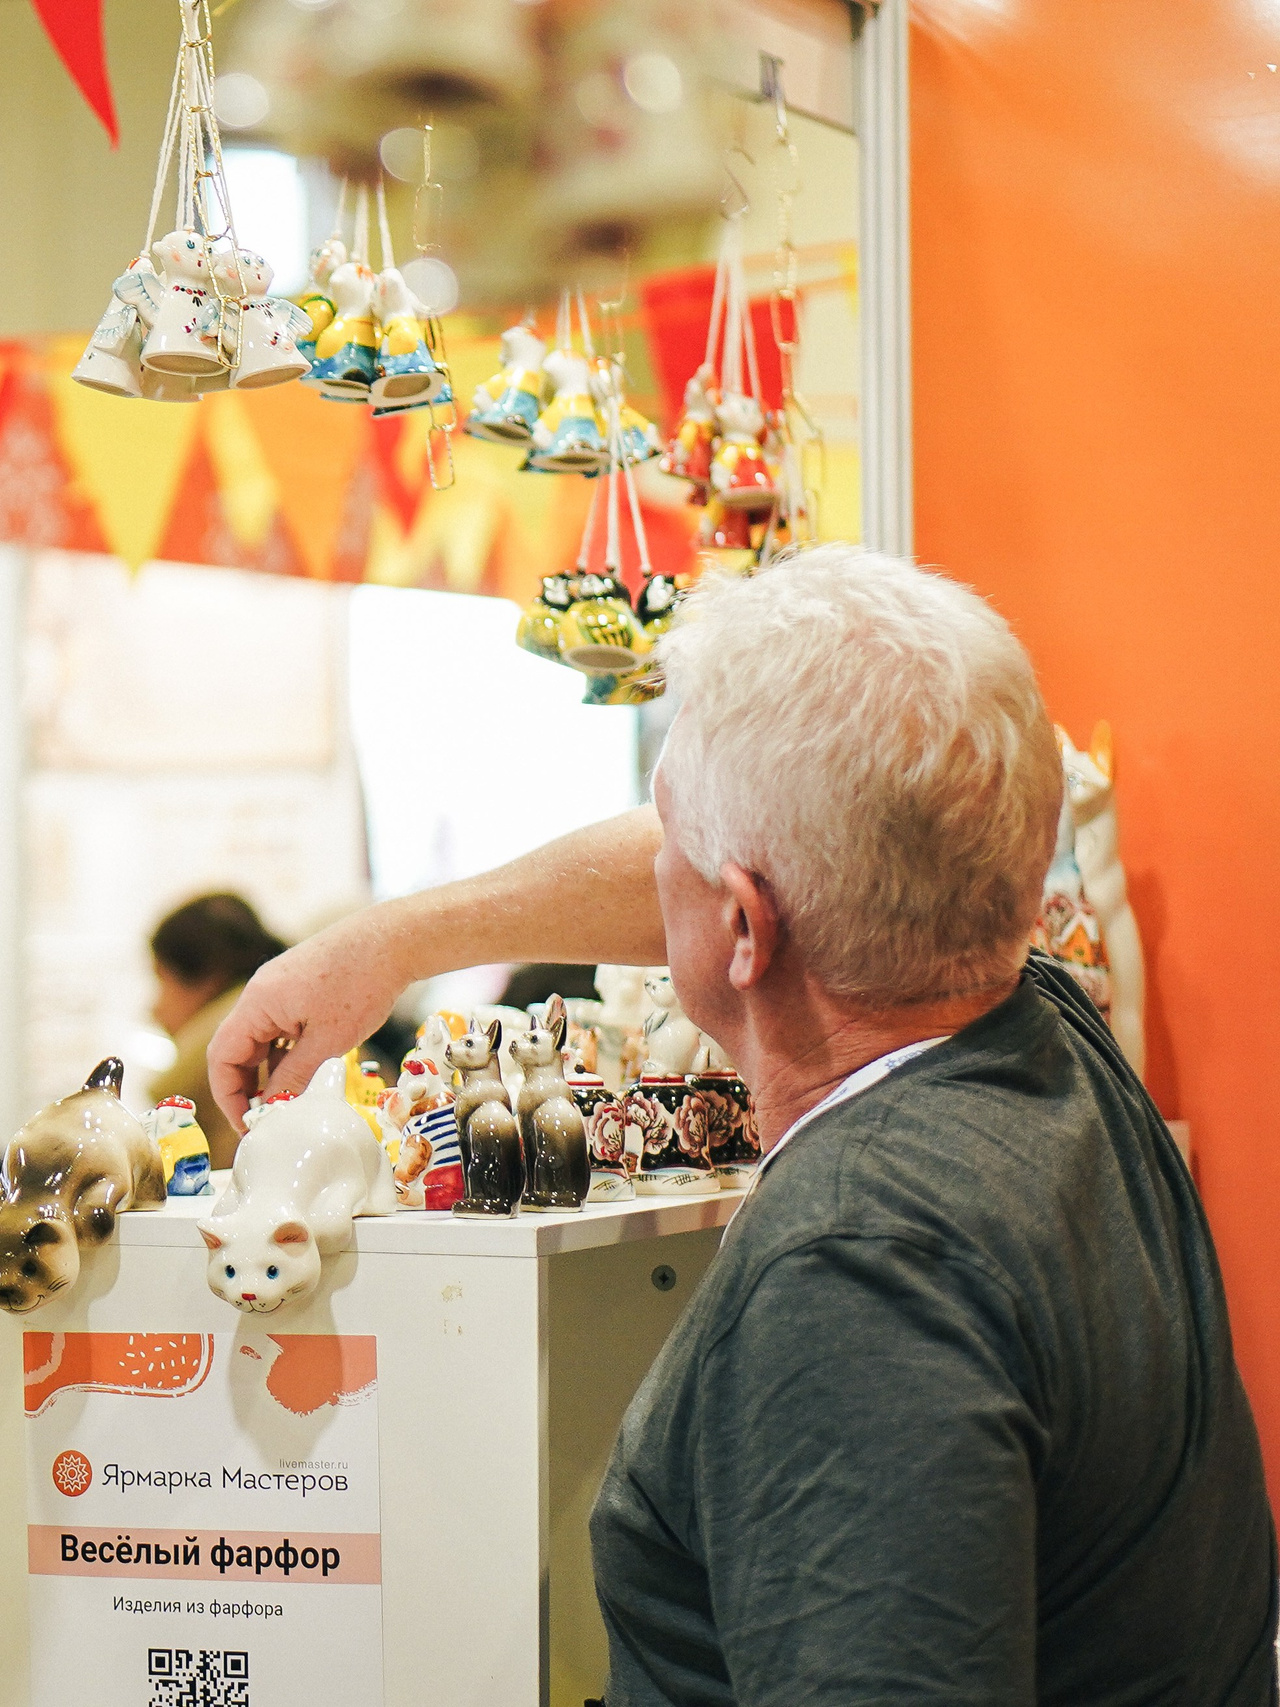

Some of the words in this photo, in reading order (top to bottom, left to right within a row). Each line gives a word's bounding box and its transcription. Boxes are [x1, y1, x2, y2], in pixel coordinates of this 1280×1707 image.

[279, 1458, 349, 1470] livemaster.ru
[102, 1463, 212, 1494] Ярмарка
[222, 1466, 349, 1497] Мастеров
[61, 1533, 200, 1566] Весёлый
[210, 1536, 340, 1576] фарфор
[113, 1596, 182, 1615] Изделия
[186, 1600, 205, 1614] из
[209, 1597, 283, 1618] фарфора
